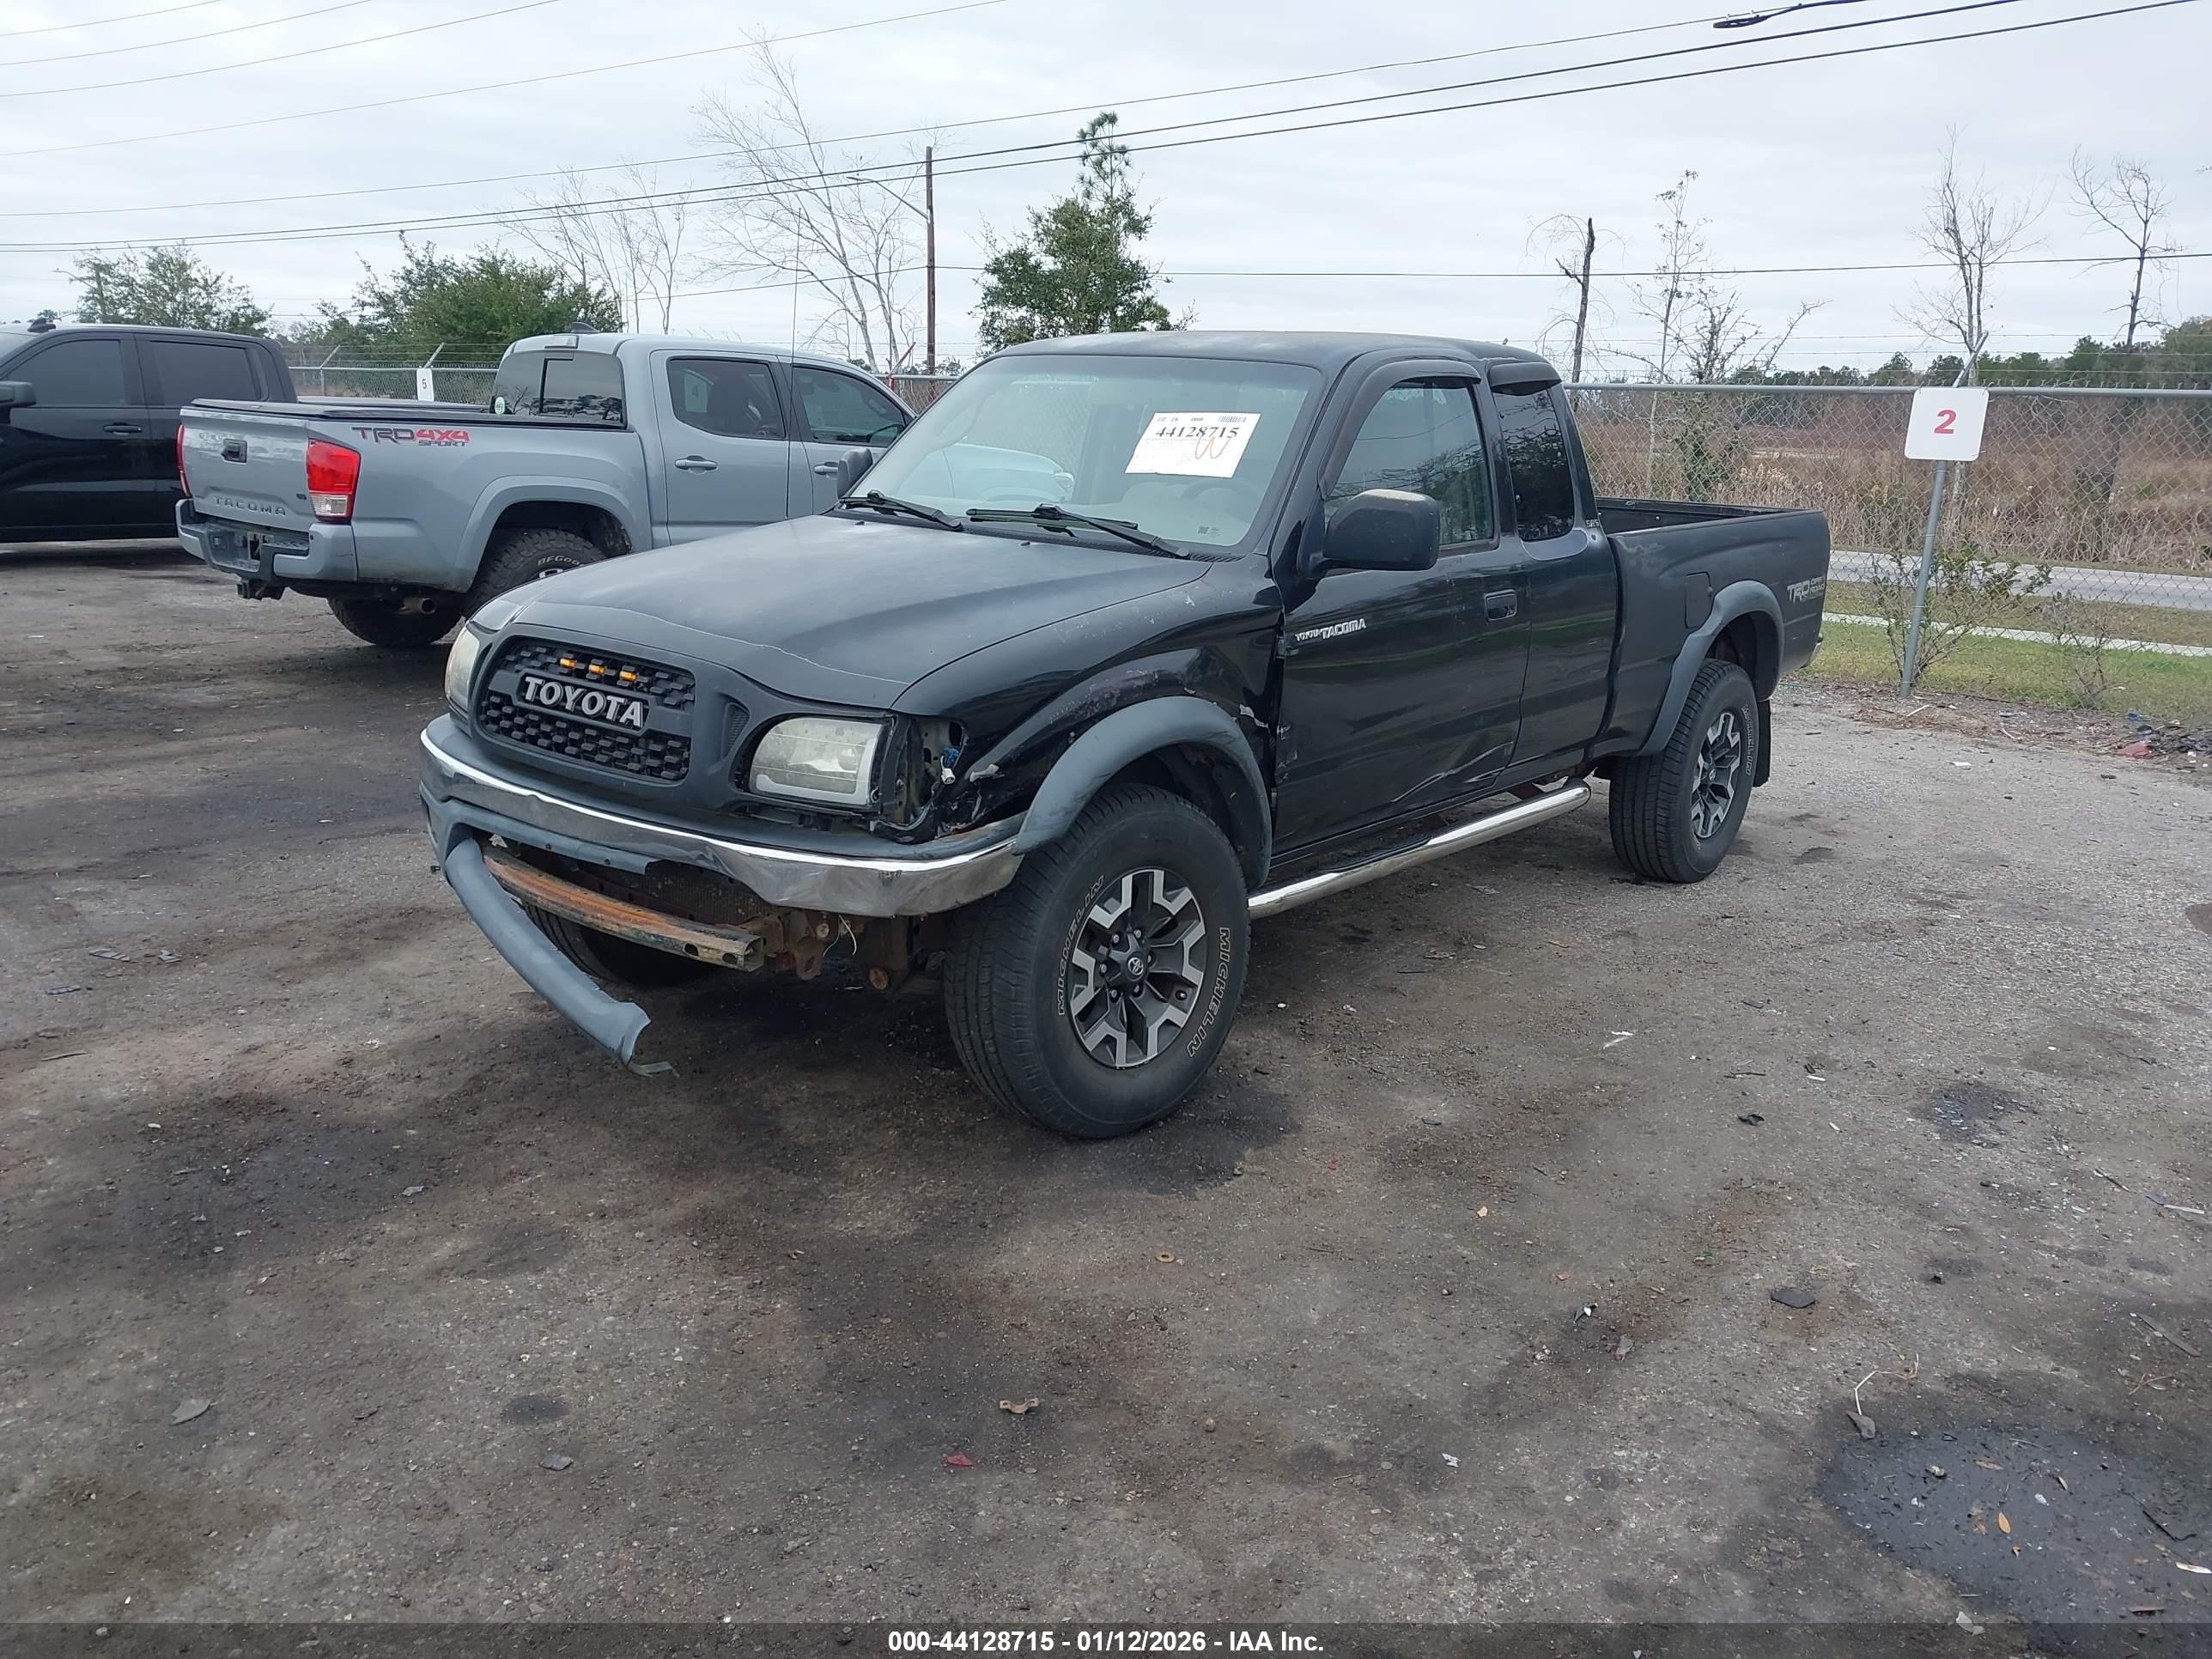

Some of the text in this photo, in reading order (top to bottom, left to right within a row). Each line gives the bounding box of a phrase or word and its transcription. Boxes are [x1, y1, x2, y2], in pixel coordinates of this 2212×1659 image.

[422, 379, 428, 390] 5
[1156, 426, 1240, 438] 44128715
[1934, 409, 1957, 434] 2
[351, 427, 416, 445] TRD
[213, 495, 287, 517] TACOMA
[1320, 618, 1367, 640] TACOMA
[525, 676, 644, 729] TOYOTA
[1057, 874, 1104, 1016] MICHELIN
[1187, 927, 1231, 1058] MICHELIN
